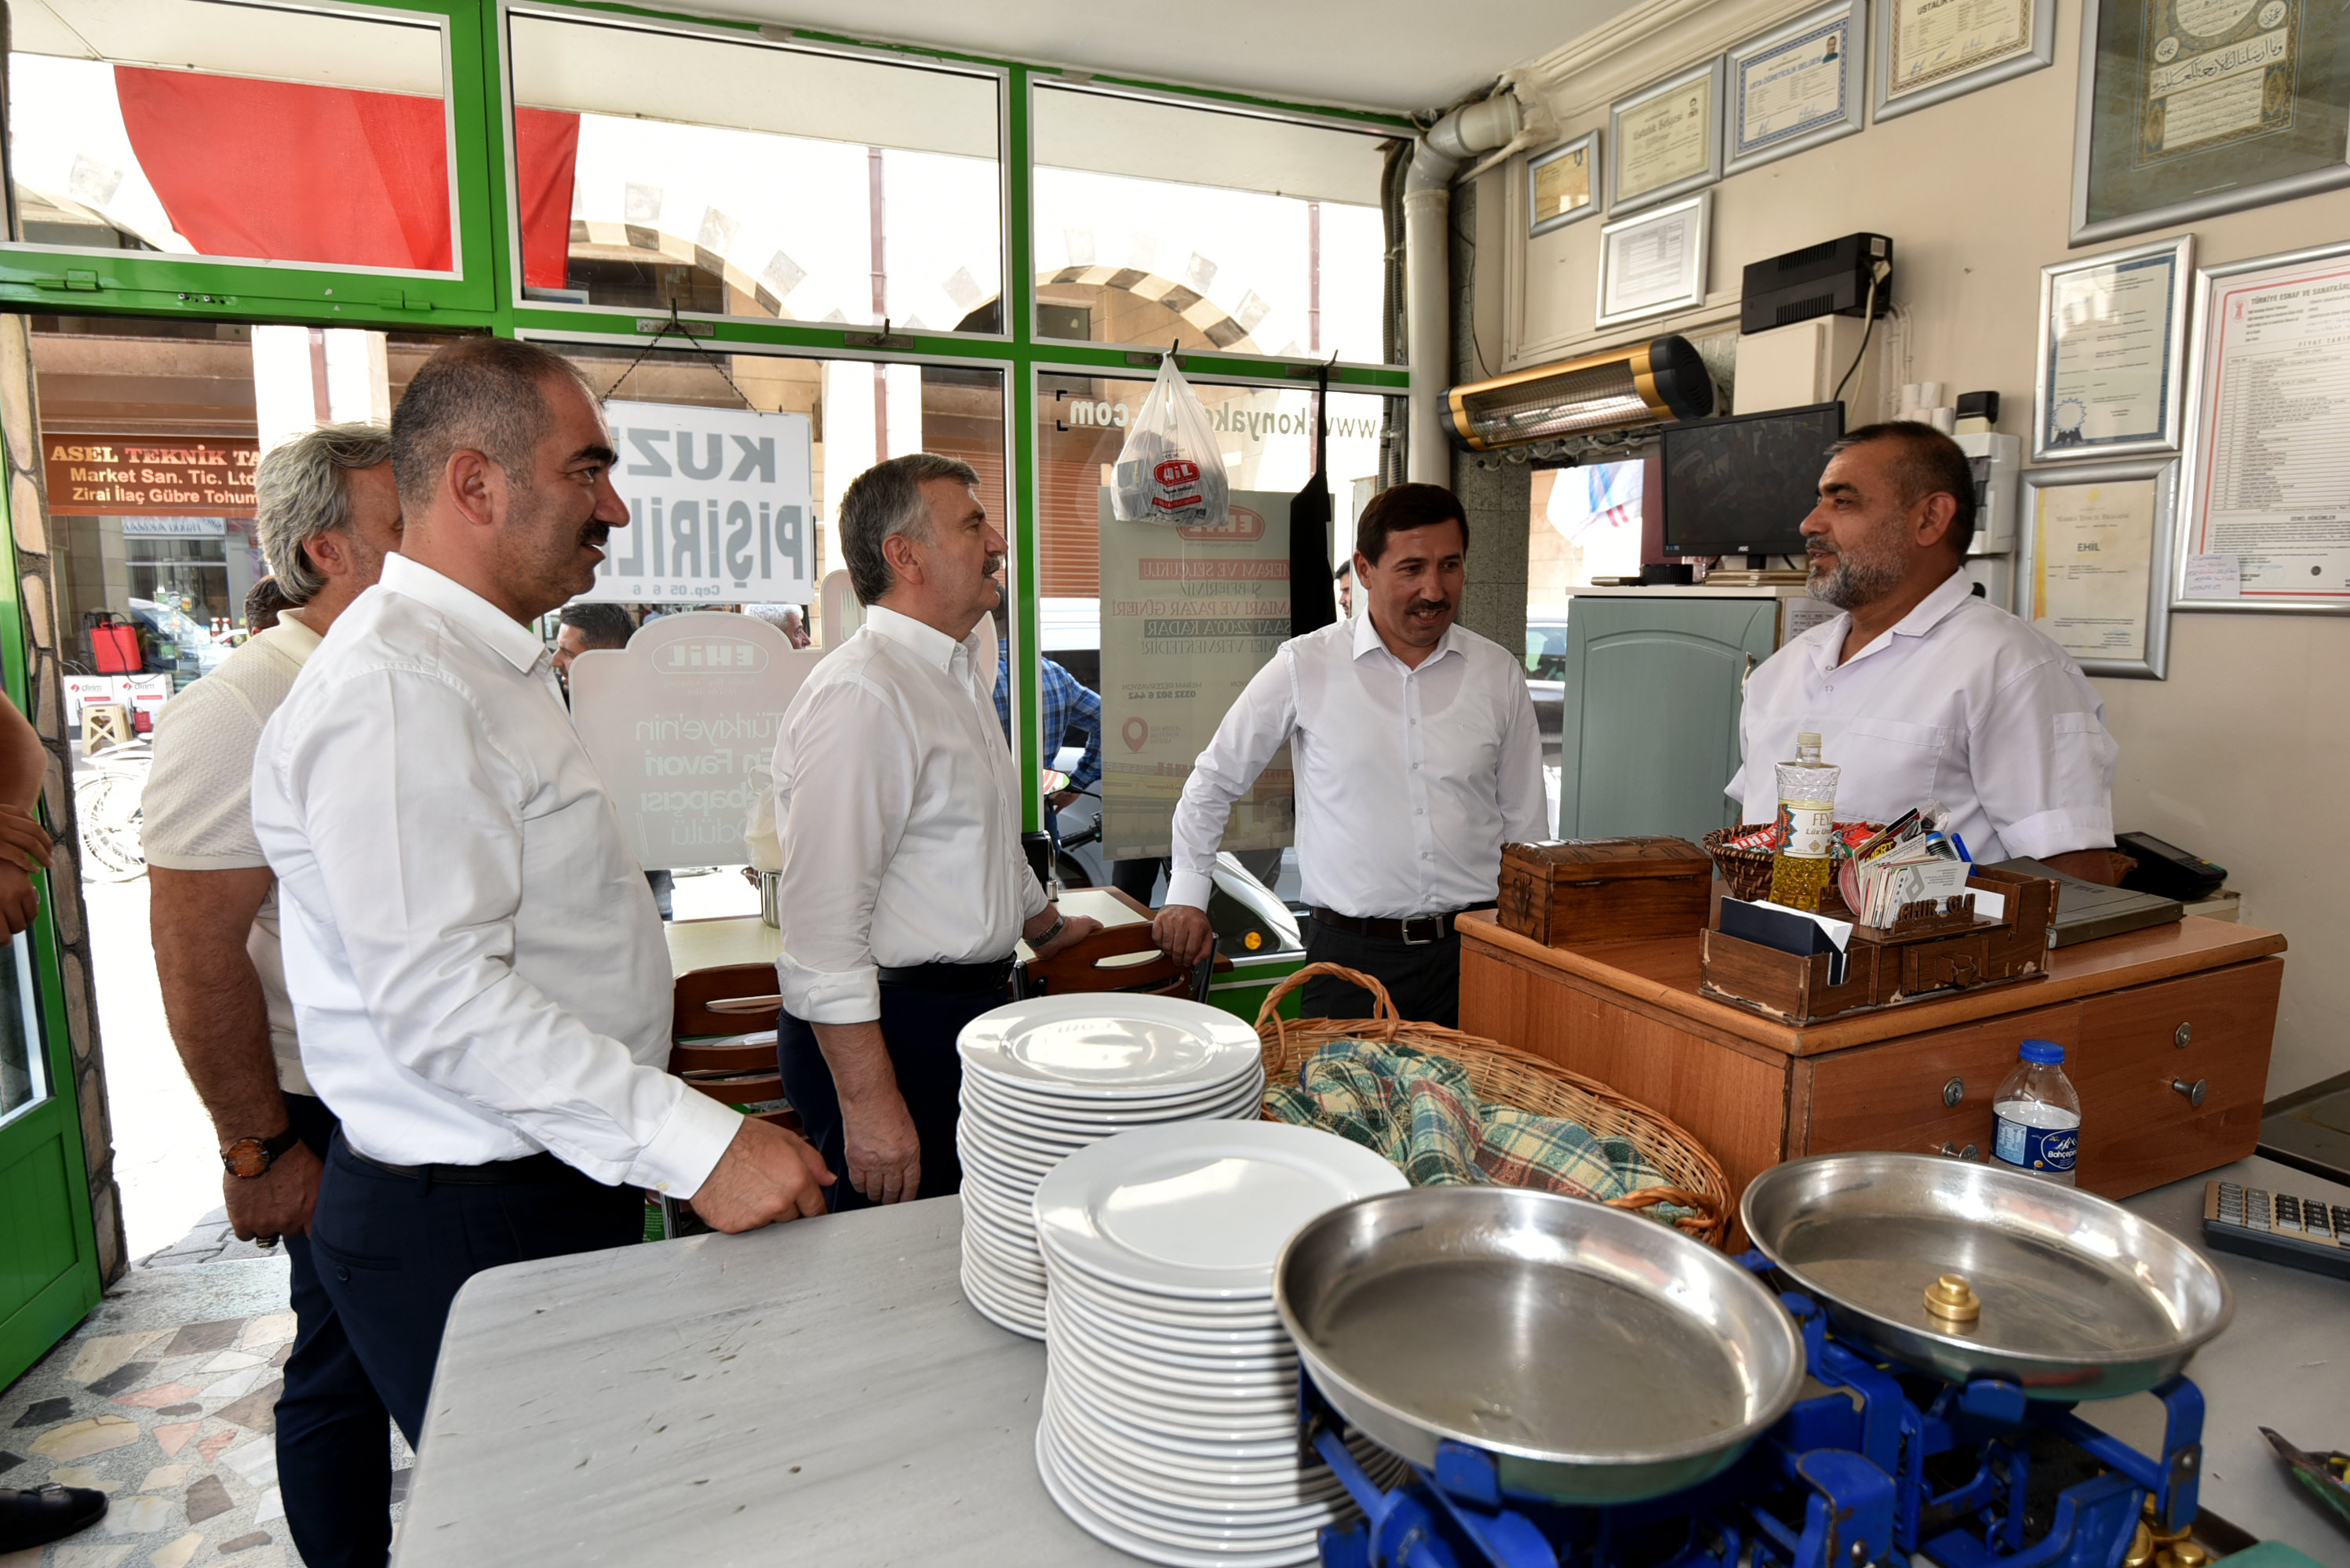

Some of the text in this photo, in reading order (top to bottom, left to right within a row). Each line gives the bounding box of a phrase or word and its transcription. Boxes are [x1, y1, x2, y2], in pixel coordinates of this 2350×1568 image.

[50, 446, 118, 463] ASEL
[125, 445, 228, 466] TEKNİK
[71, 467, 137, 483] Market
[141, 469, 184, 485] San.
[188, 470, 222, 486] Tic.
[72, 487, 111, 501] Zirai
[115, 485, 145, 505] İlaç
[149, 488, 200, 503] Gübre
